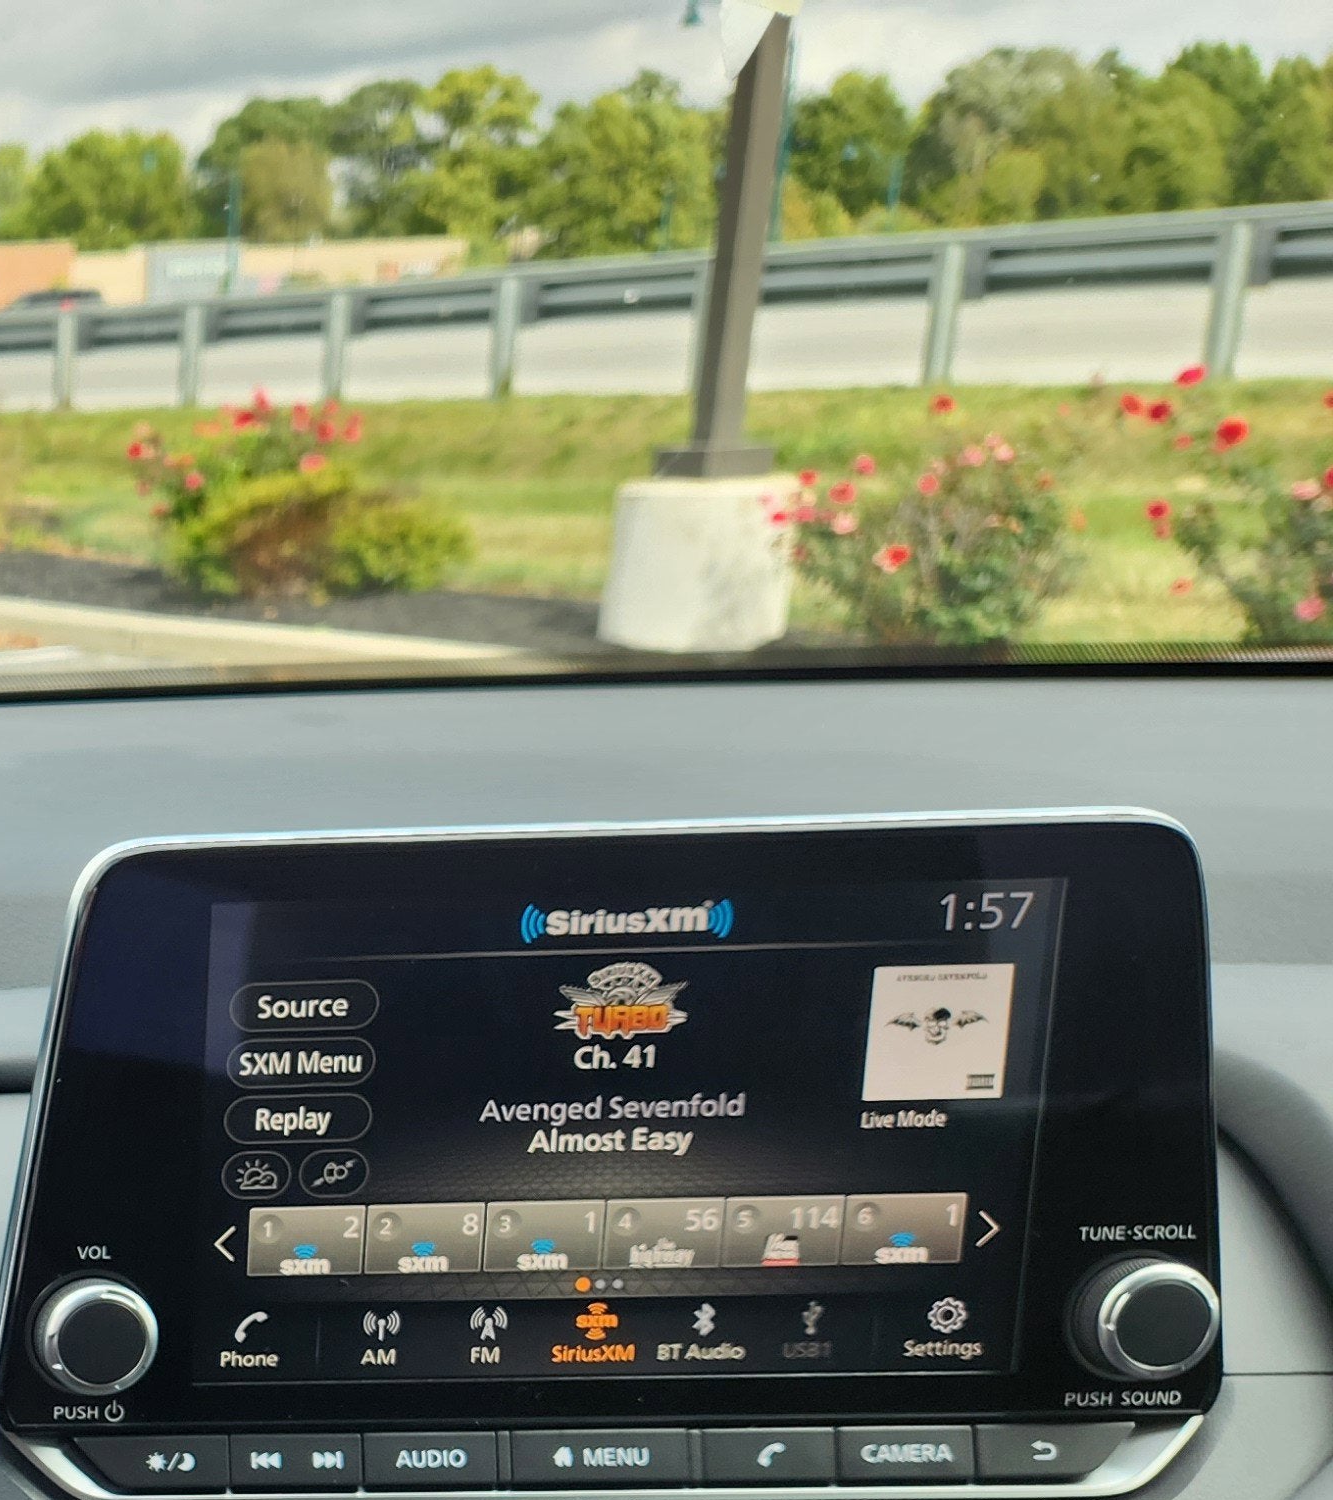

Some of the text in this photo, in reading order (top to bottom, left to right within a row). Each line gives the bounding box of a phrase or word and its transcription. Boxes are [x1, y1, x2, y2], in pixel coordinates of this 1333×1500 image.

[940, 891, 1033, 932] 1:57
[257, 995, 349, 1020] Source
[575, 1004, 670, 1037] TURBO
[239, 1051, 362, 1076] SXM Menu
[574, 1044, 656, 1070] Ch. 41
[479, 1092, 746, 1126] Avenged Sevenfold
[860, 1109, 948, 1129] Live Mode
[255, 1107, 331, 1137] Replay
[527, 1128, 694, 1156] Almost Easy
[462, 1213, 479, 1236] 8
[498, 1215, 511, 1233] 3
[584, 1211, 596, 1233] 1
[618, 1213, 632, 1230] 4
[684, 1208, 720, 1232] 56
[789, 1206, 840, 1230] 114
[945, 1203, 959, 1227] 1
[263, 1222, 273, 1238] 1
[342, 1216, 360, 1239] 2
[380, 1217, 393, 1236] 2
[77, 1246, 111, 1260] VOL
[516, 1252, 569, 1271] sxm
[279, 1258, 331, 1275] sxm
[397, 1255, 449, 1273] sxm
[576, 1311, 618, 1330] sxm
[220, 1351, 279, 1369] Phone
[361, 1348, 397, 1366] AM
[470, 1346, 500, 1365] FM
[551, 1344, 636, 1363] SiriusXM
[656, 1342, 746, 1361] BT Audio
[903, 1339, 983, 1361] Settings
[1064, 1390, 1182, 1407] PUSH SOUND
[53, 1406, 99, 1421] PUSH
[396, 1448, 467, 1469] AUDIO
[583, 1445, 650, 1468] MENU
[861, 1442, 952, 1465] CAMERA
